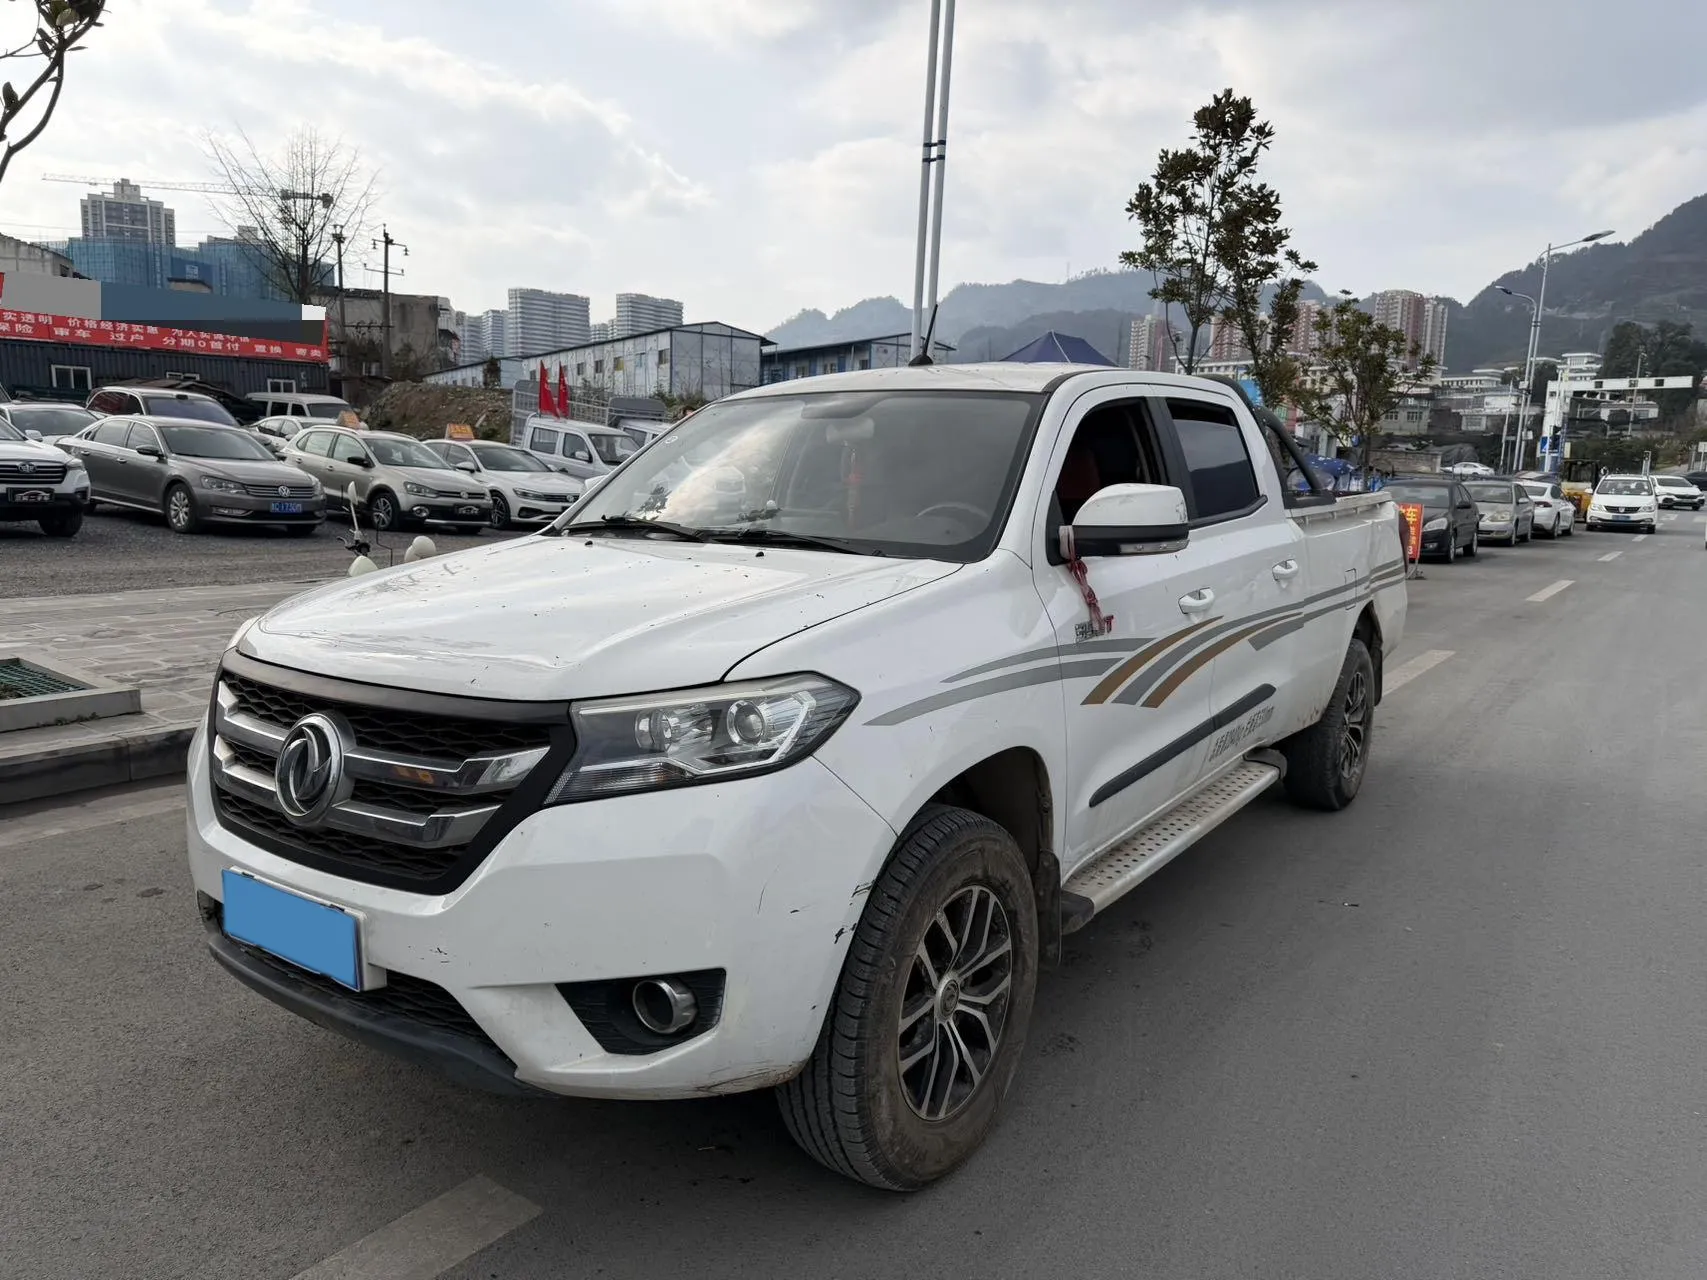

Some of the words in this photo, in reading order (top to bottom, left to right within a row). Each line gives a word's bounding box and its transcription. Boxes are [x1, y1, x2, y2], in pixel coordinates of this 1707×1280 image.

[67, 317, 159, 334] 价格经济实惠
[109, 331, 144, 342] 过户
